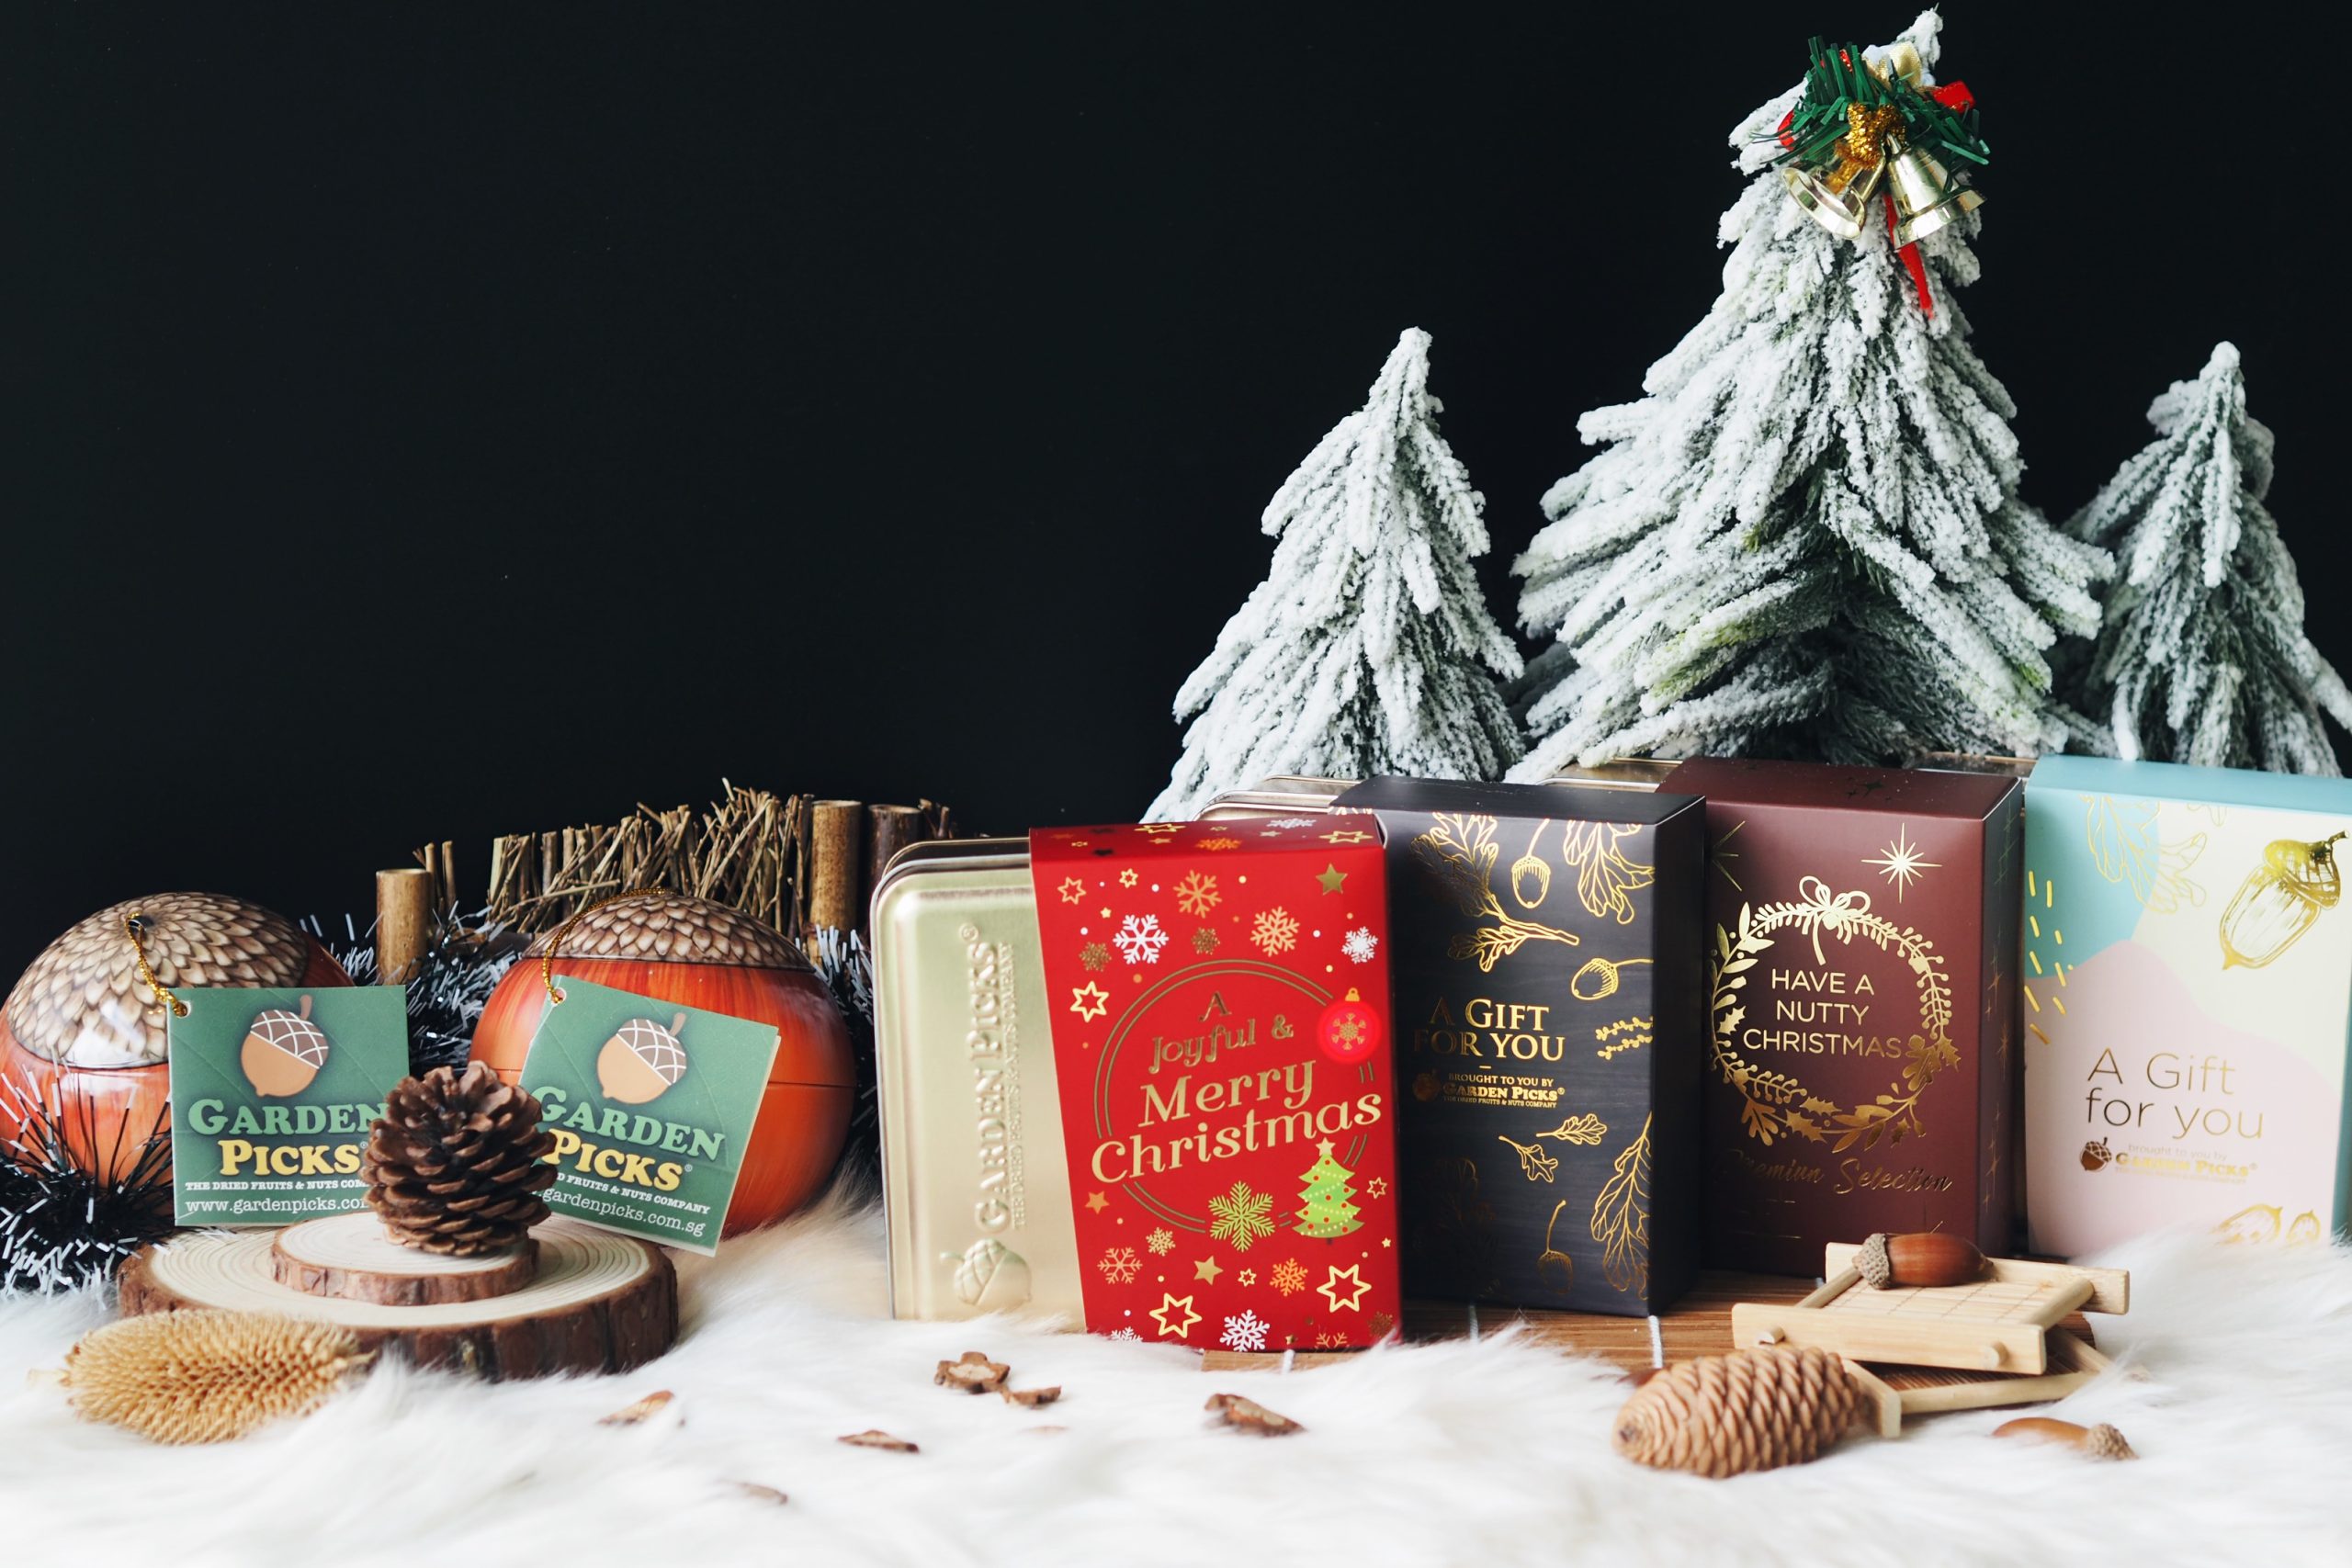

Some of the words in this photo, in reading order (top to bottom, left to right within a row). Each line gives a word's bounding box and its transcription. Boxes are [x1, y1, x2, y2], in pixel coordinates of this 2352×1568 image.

[1772, 968, 1846, 994] HAVE
[1854, 974, 1874, 995] A
[1200, 991, 1232, 1021] A
[1430, 996, 1455, 1026] A
[1464, 998, 1550, 1032] GIFT
[1777, 999, 1869, 1025] NUTTY
[1148, 1019, 1257, 1074] Joyful
[1271, 1014, 1294, 1041] &
[1413, 1029, 1484, 1057] FOR
[1489, 1032, 1565, 1061] YOU
[1743, 1028, 1902, 1058] CHRISTMAS
[1448, 1072, 1498, 1084] BROUGHT
[1500, 1076, 1515, 1085] TO
[1517, 1077, 1539, 1087] YOU
[1541, 1078, 1554, 1087] BY
[2087, 1047, 2123, 1084] A
[2146, 1053, 2235, 1095] Gift
[1138, 1059, 1316, 1127] Merry
[188, 1098, 388, 1136] GARDEN
[530, 1086, 725, 1161] GARDEN
[2086, 1087, 2154, 1127] for
[2172, 1105, 2263, 1139] you
[974, 1068, 1010, 1234] GARDEN
[1091, 1093, 1382, 1183] Christmas
[185, 1181, 210, 1190] THE
[212, 1181, 248, 1190] DRIED
[251, 1181, 293, 1190] FRUITS
[295, 1181, 304, 1190] &
[307, 1180, 338, 1190] NUTS
[566, 1174, 608, 1192] FRUITS
[610, 1185, 620, 1194] &
[620, 1188, 652, 1201] NUTS
[653, 1195, 711, 1215] COMPANY
[532, 1187, 707, 1237] .gardenpicks.com.sg
